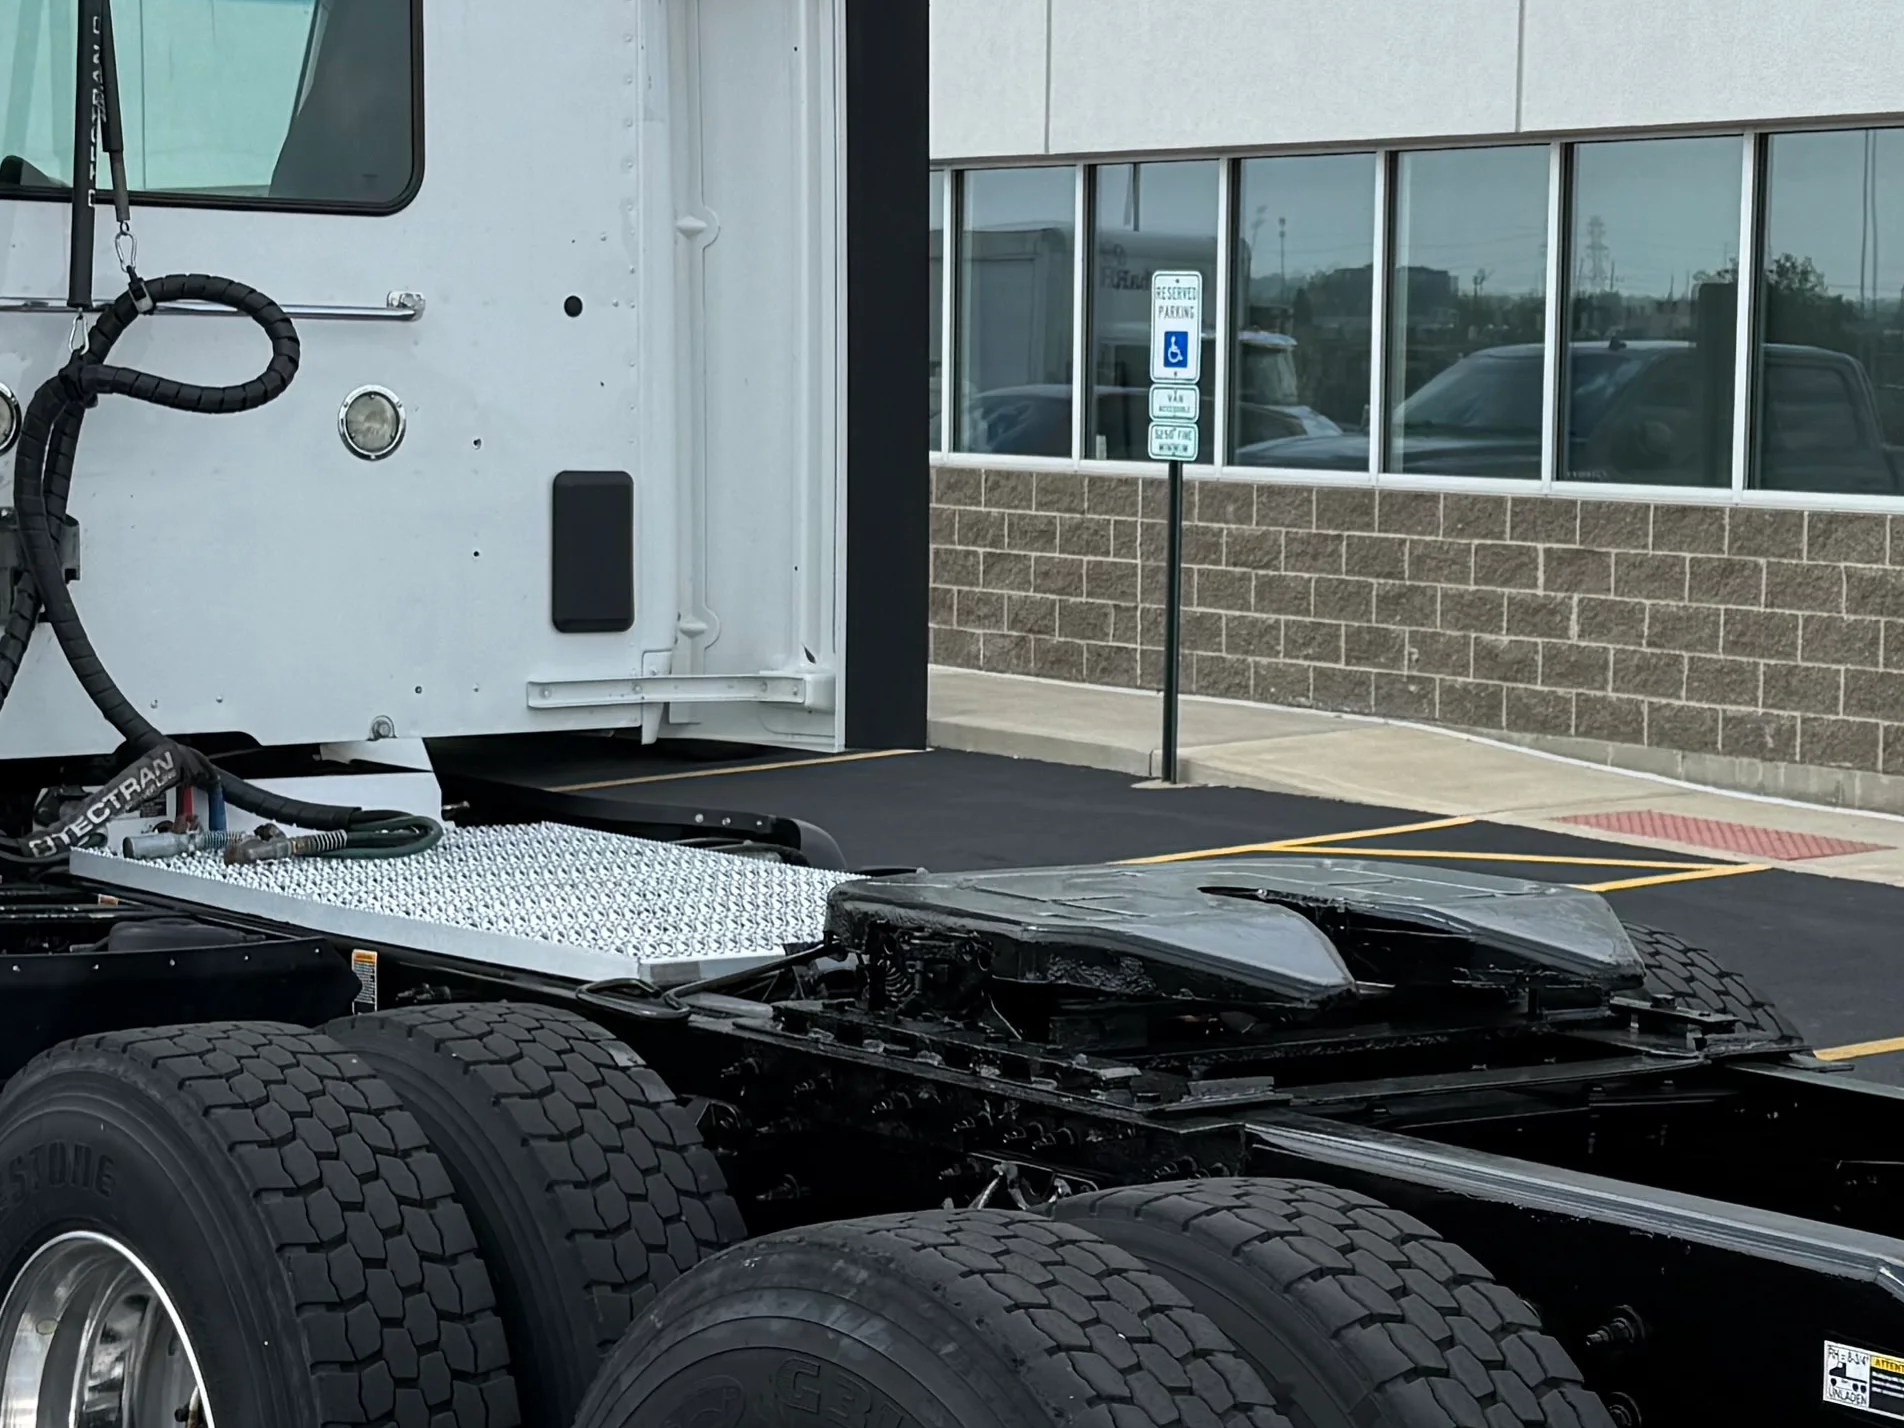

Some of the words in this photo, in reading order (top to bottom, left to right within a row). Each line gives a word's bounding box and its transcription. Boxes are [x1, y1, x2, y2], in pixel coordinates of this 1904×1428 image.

[1156, 287, 1197, 300] RESERVED
[1158, 305, 1195, 319] PARKING
[1168, 394, 1184, 404] VAN
[1177, 429, 1192, 441] FINE
[51, 751, 174, 846] TECTRAN
[1828, 1385, 1867, 1405] UNLADEN
